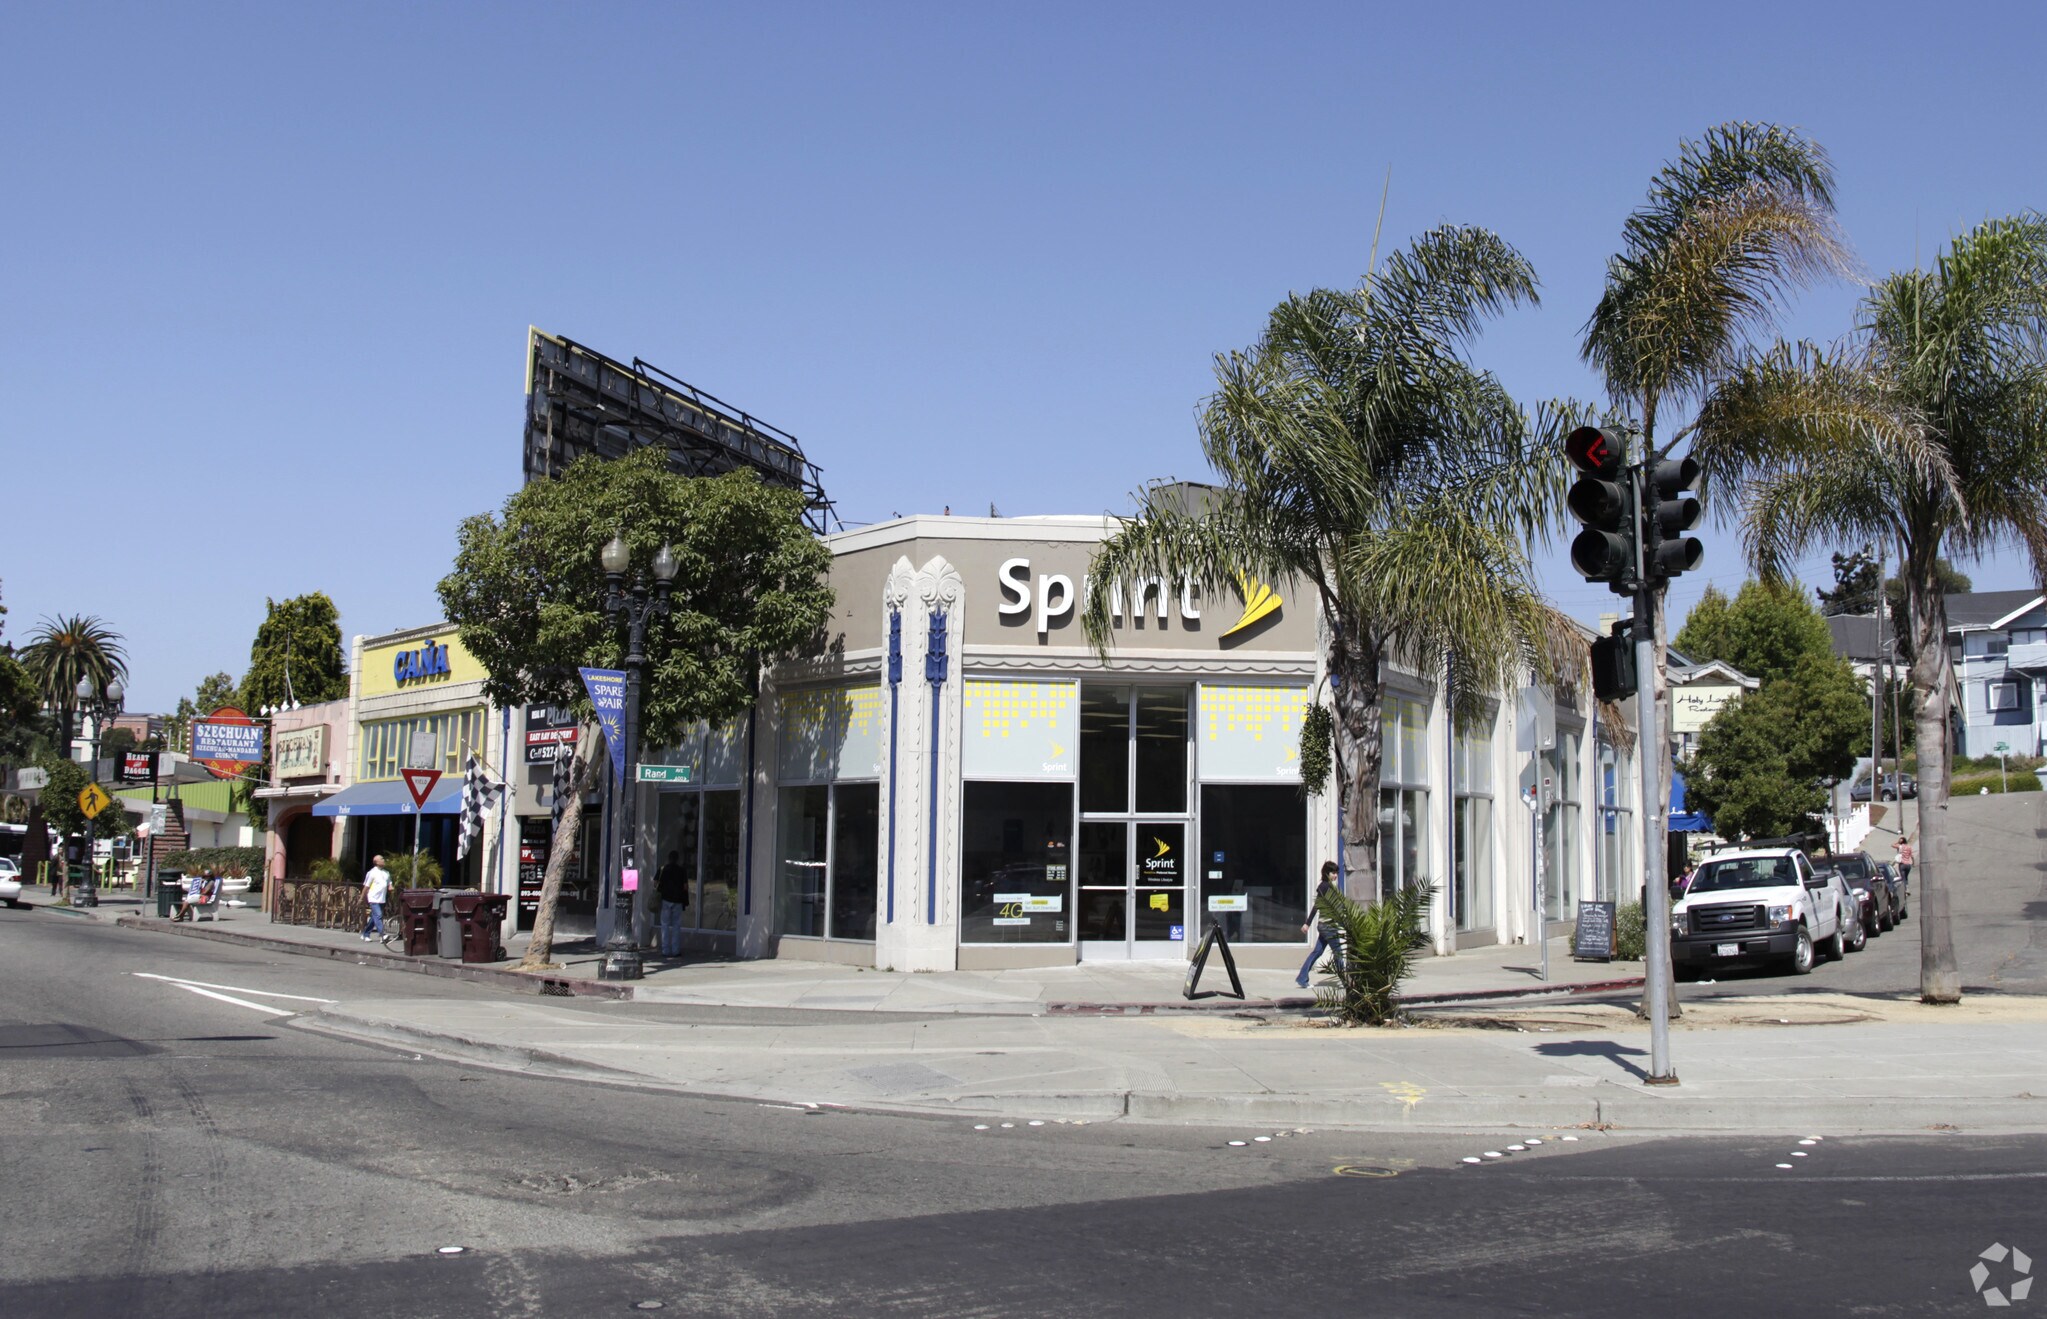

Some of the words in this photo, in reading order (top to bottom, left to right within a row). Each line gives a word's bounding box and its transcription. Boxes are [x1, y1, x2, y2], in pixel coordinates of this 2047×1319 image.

[393, 639, 449, 681] CAÑA
[587, 674, 623, 683] LAKESHORE
[594, 684, 624, 697] SPARE
[605, 698, 623, 710] AIR
[1677, 694, 1703, 705] Holy
[547, 706, 571, 725] PIZZA
[197, 724, 259, 740] SZECHUAN
[529, 732, 540, 741] EAST
[201, 737, 255, 748] RESTAURANT
[126, 752, 150, 761] HEART
[124, 766, 150, 775] DAGGER
[1042, 762, 1067, 773] Sprint
[1275, 766, 1300, 776] Sprint
[644, 768, 667, 779] Rand
[1145, 858, 1175, 870] Sprint
[999, 902, 1024, 918] 4G
